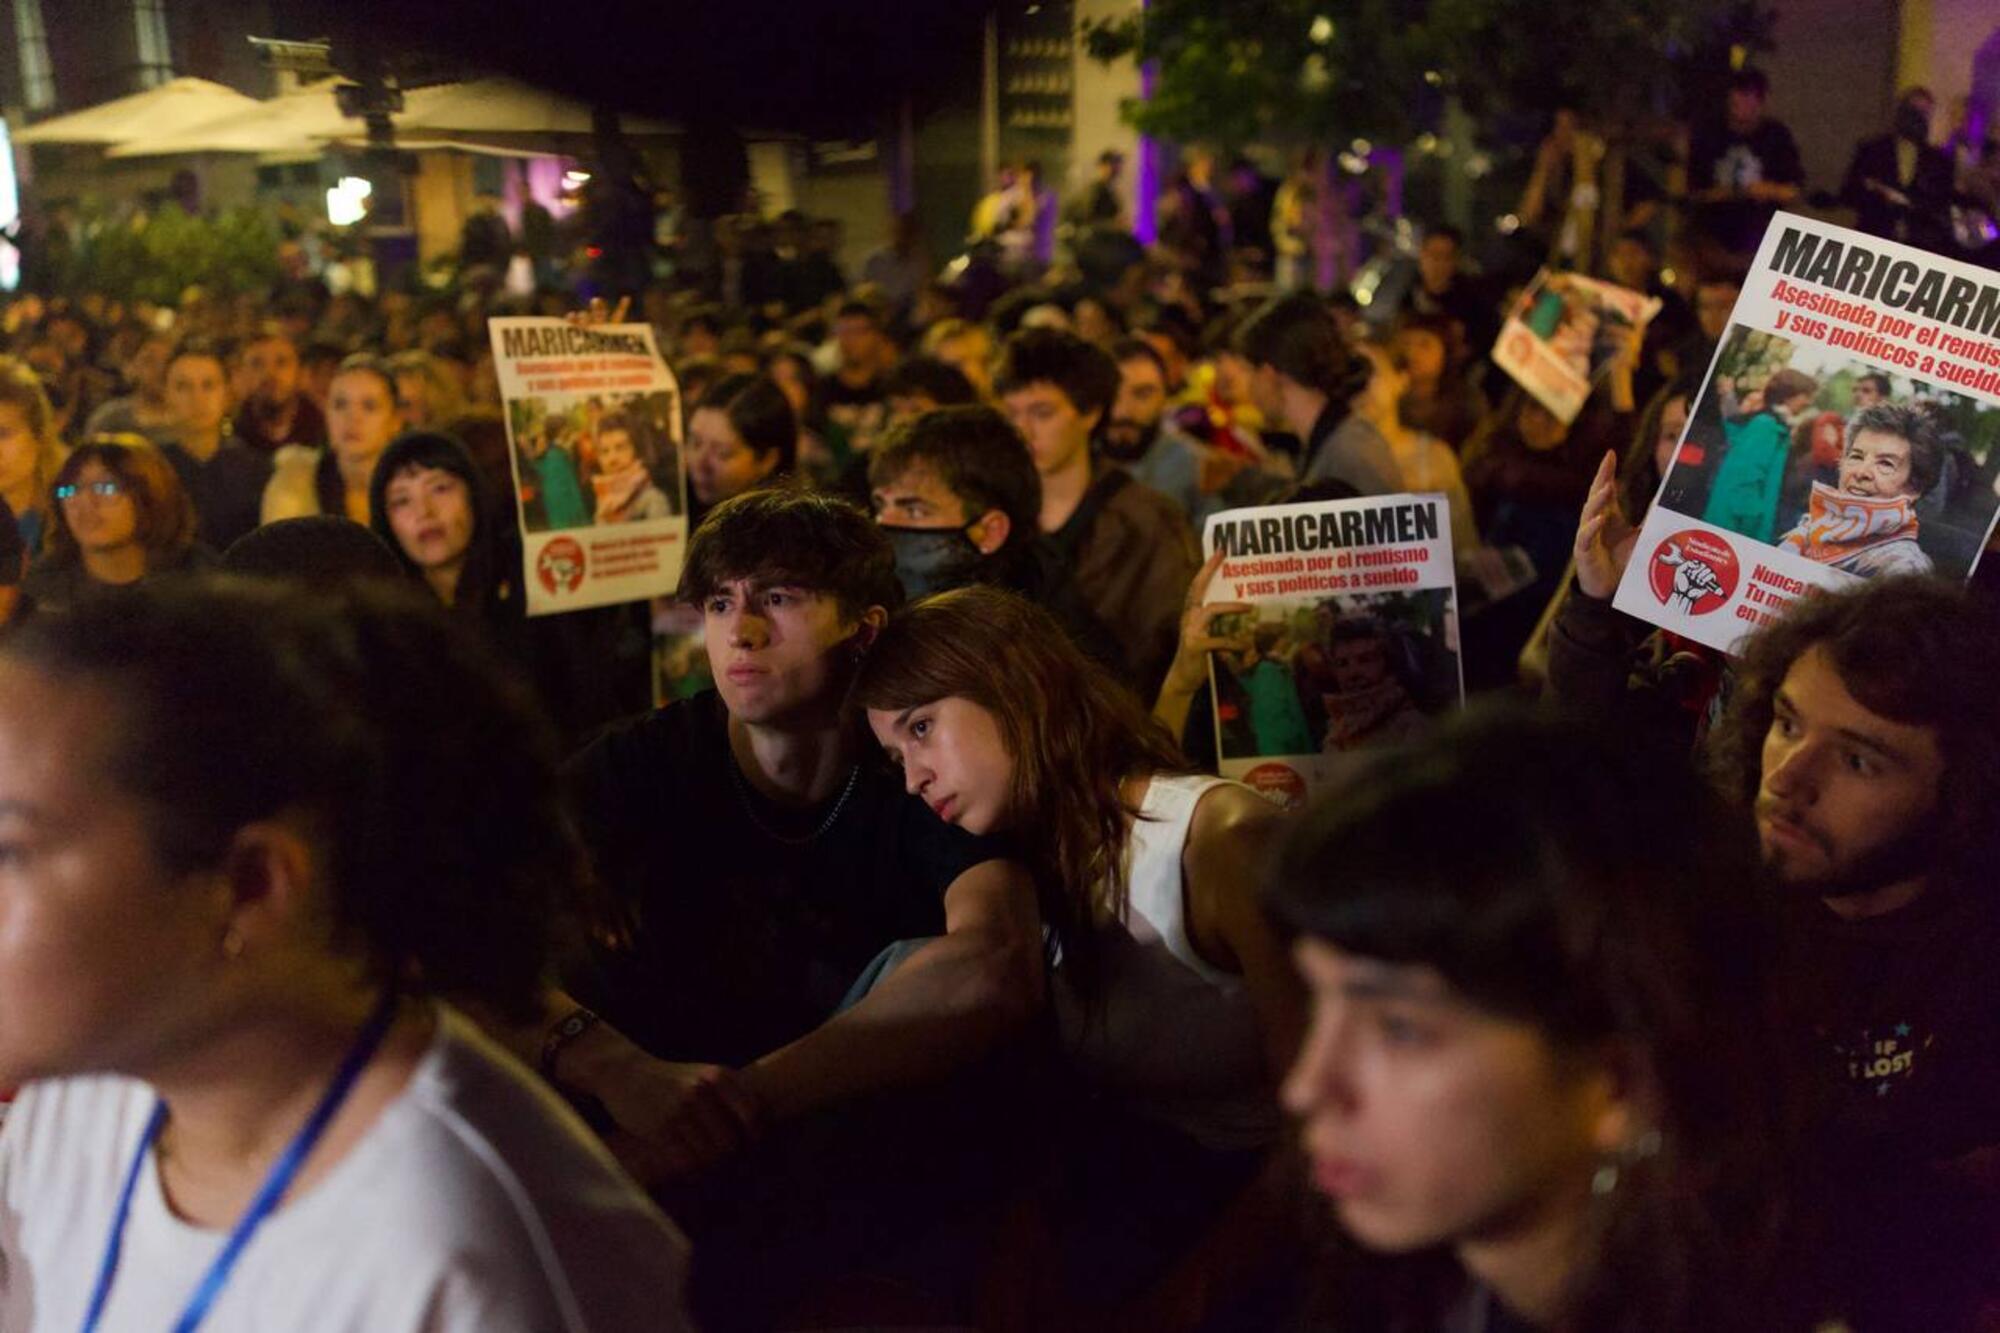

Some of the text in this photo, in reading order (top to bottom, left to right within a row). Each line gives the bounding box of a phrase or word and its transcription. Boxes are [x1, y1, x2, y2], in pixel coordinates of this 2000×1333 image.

[1771, 279, 1877, 328] Asesinada
[1877, 313, 1916, 344] por
[1916, 327, 1939, 347] el
[1774, 310, 1791, 330] y
[1790, 315, 1828, 340] sus
[1919, 355, 1935, 373] a
[1213, 503, 1438, 557] MARICARMEN
[1222, 547, 1428, 579] Asesinada por el rentismo
[1235, 583, 1244, 599] y
[1247, 579, 1275, 595] sus
[1351, 573, 1360, 588] a
[1364, 567, 1418, 586] sueldo
[1744, 582, 1765, 604] Tu
[1751, 564, 1804, 595] Nunca
[1735, 604, 1758, 623] en
[1875, 1040, 1897, 1055] IF
[1864, 1050, 1914, 1078] LOST
